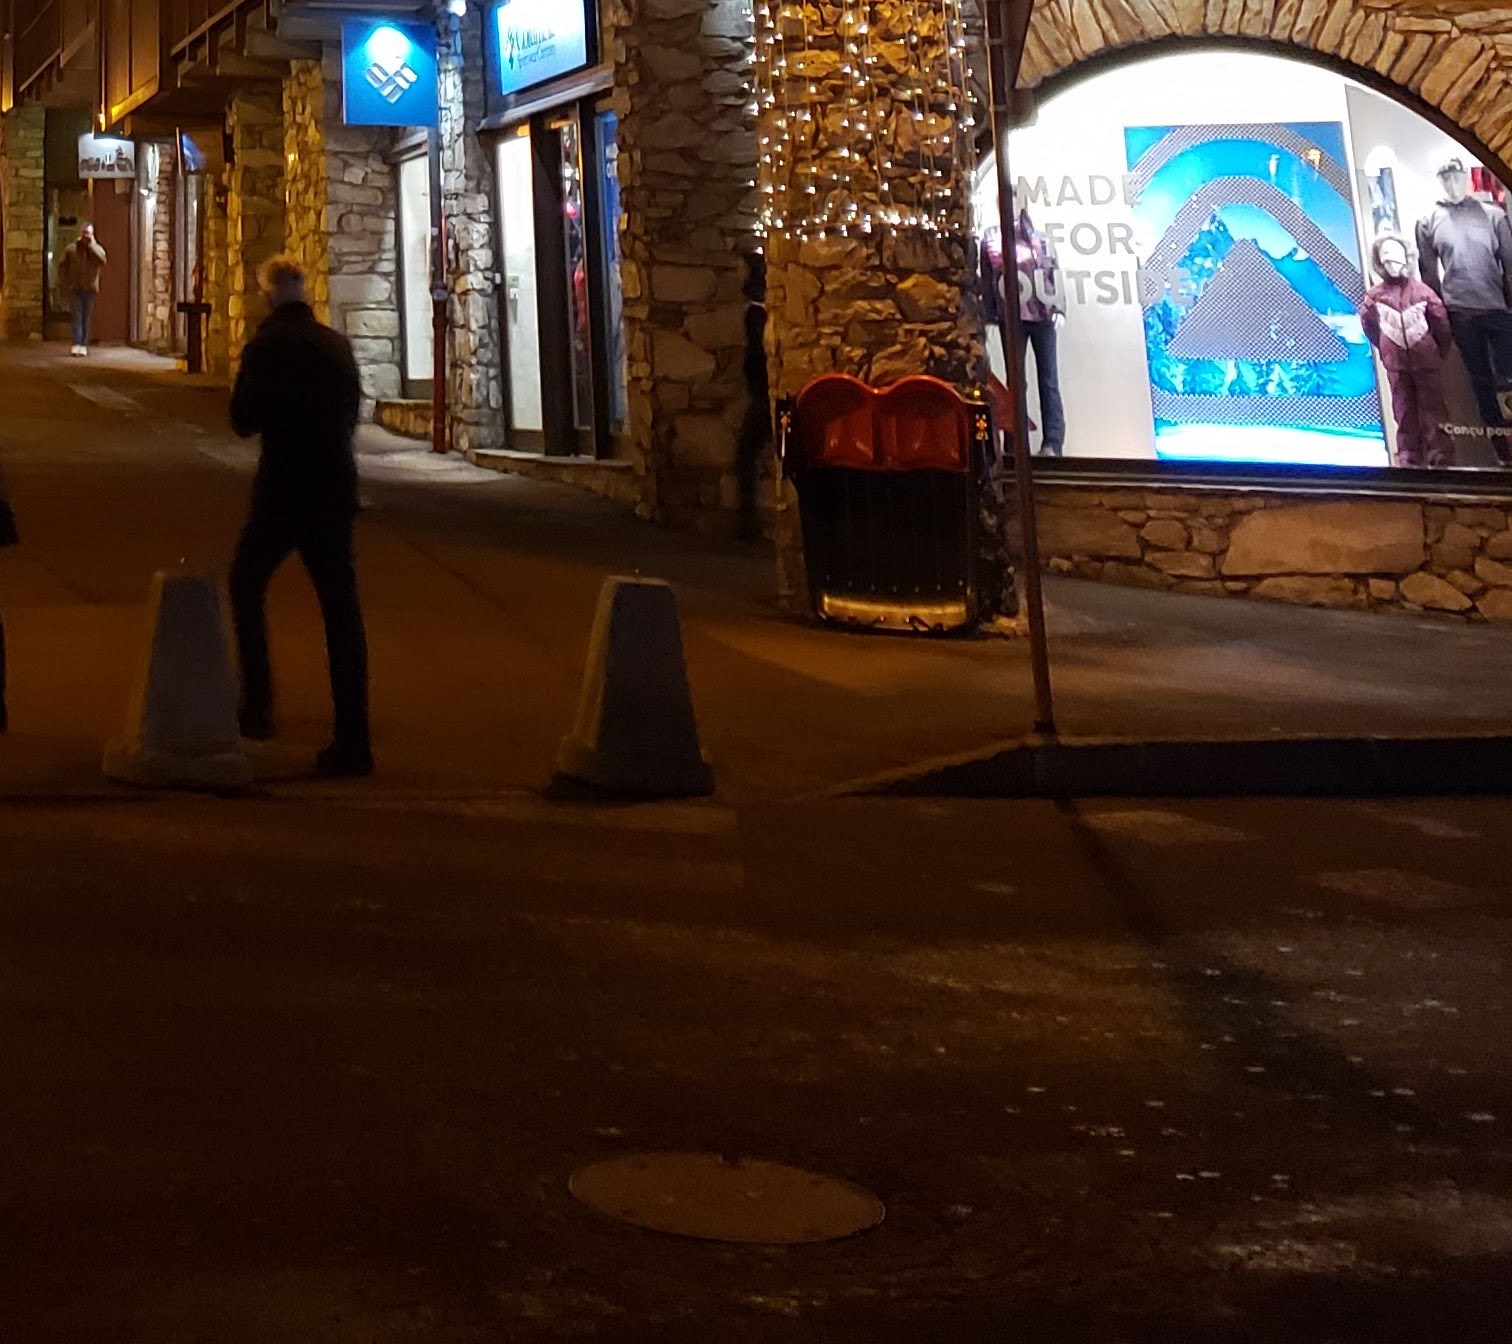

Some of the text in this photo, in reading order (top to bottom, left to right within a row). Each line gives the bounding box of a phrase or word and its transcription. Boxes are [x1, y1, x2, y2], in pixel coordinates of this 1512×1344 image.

[1013, 174, 1143, 208] MADE
[1044, 222, 1136, 256] FOR
[997, 268, 1195, 306] OUTSIDE
